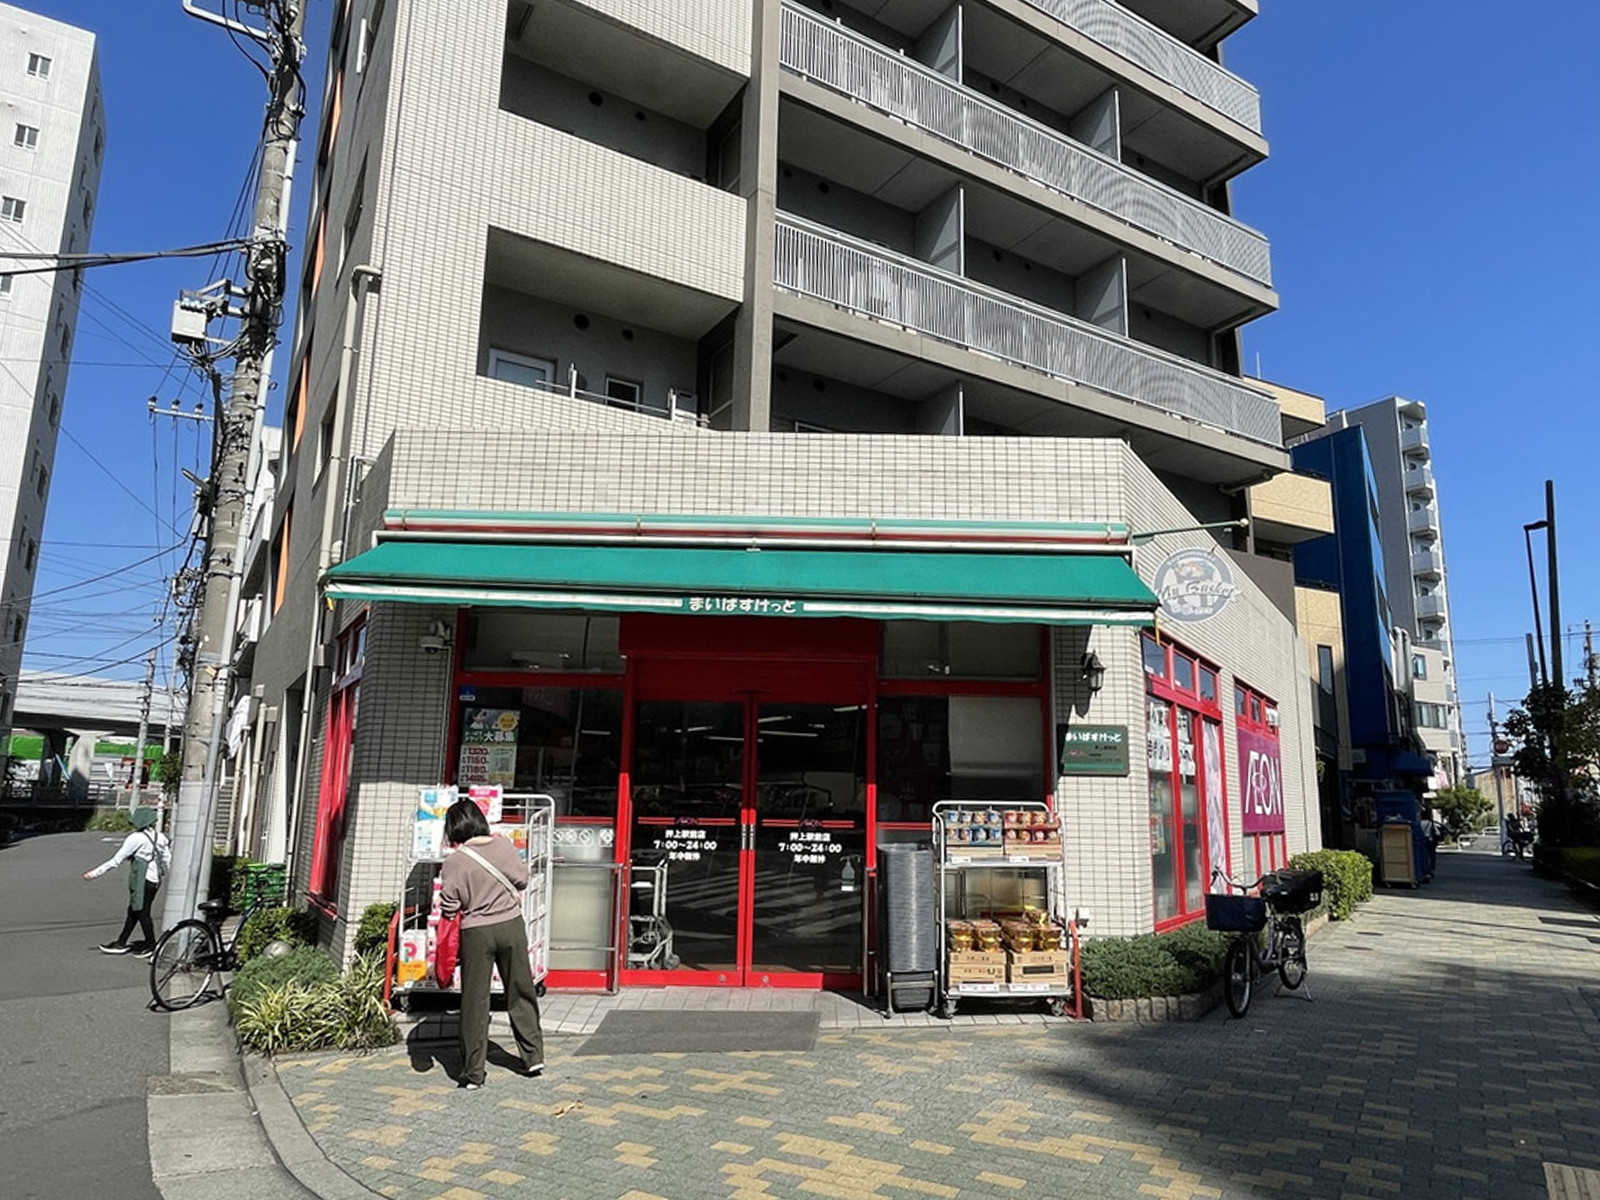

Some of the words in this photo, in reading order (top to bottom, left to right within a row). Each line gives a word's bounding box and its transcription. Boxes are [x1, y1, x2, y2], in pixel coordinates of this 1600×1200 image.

[689, 597, 796, 613] まいばすけっと
